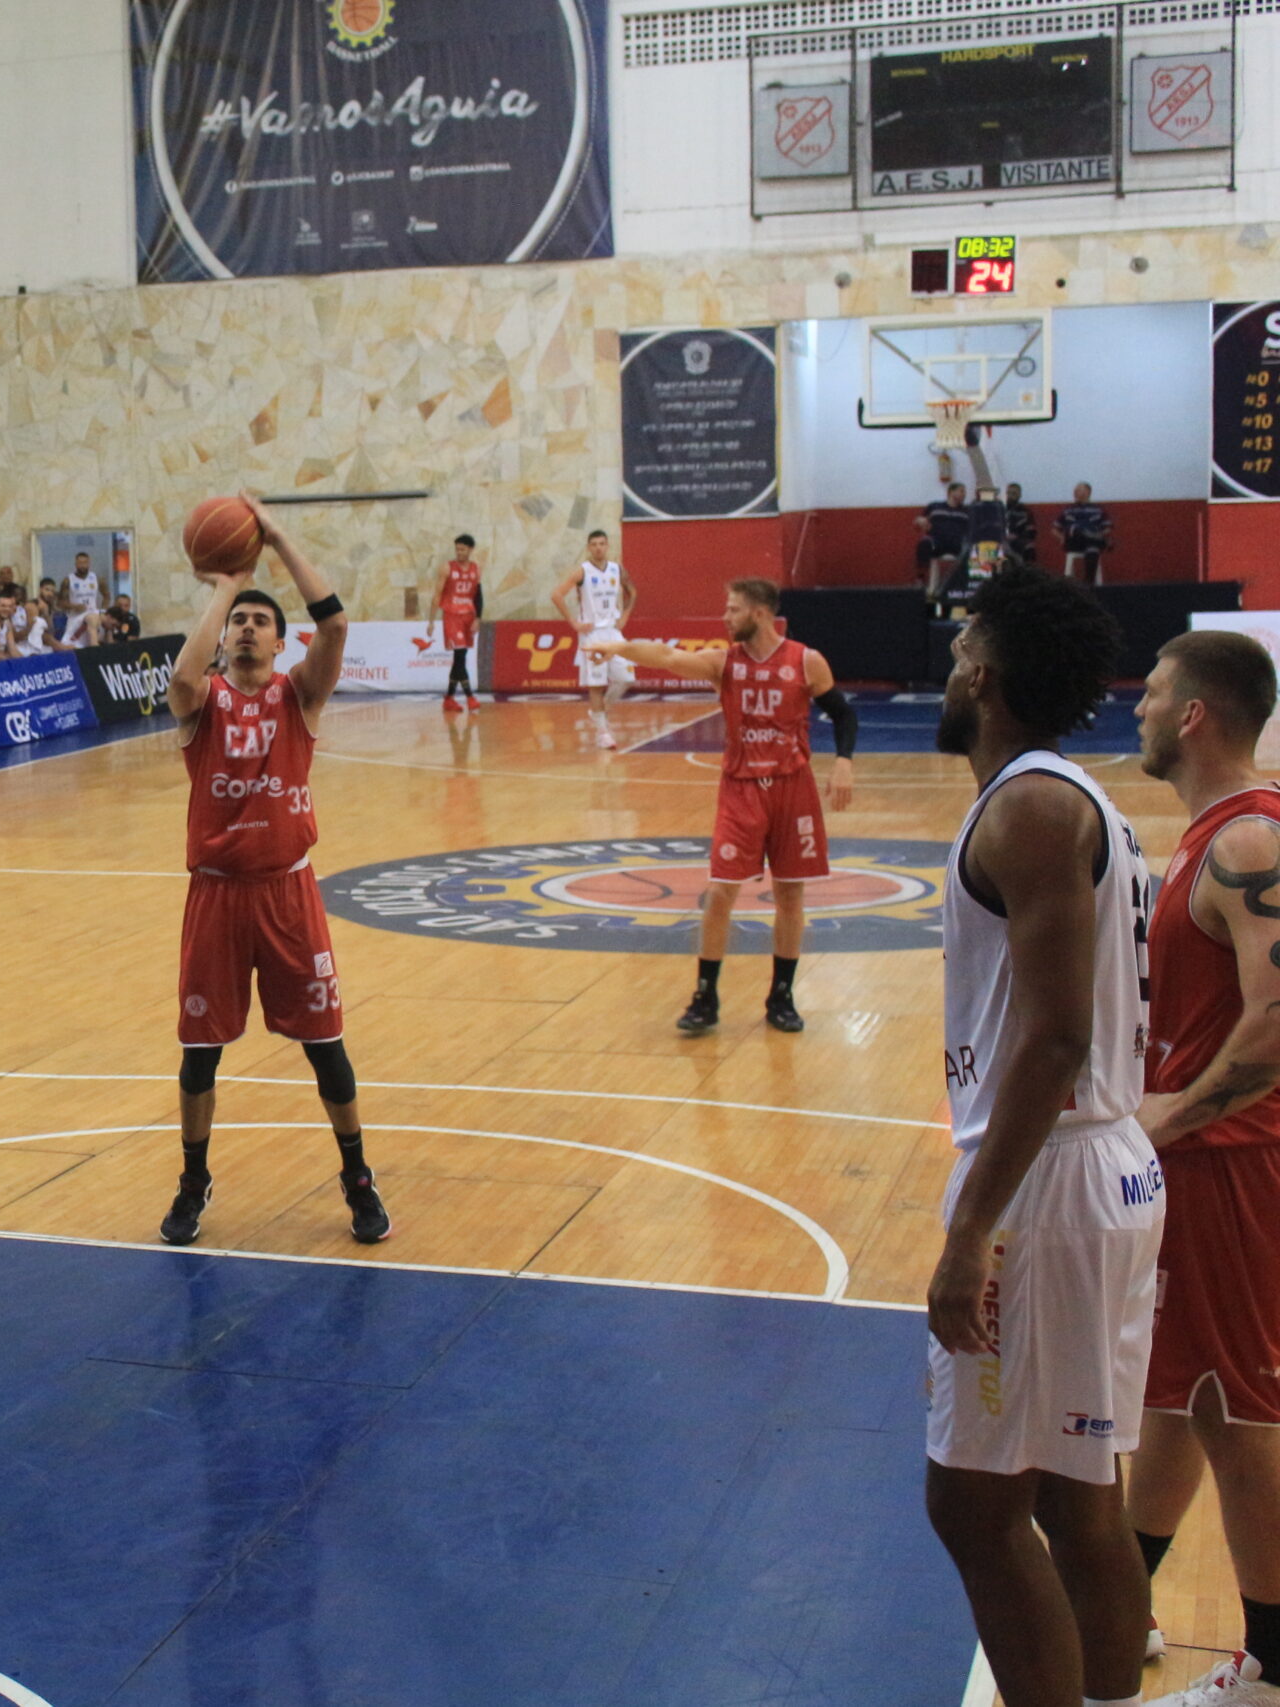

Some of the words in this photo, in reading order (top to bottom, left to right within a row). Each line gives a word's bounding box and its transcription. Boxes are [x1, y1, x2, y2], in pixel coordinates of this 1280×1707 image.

[941, 44, 1035, 63] HARDSPORT
[877, 169, 981, 193] A.E.S.J.
[1002, 158, 1110, 185] VISITANTE
[958, 238, 1014, 258] 08:32
[968, 260, 1014, 294] 24
[1246, 371, 1269, 387] #0
[1244, 393, 1268, 408] #5
[1242, 413, 1273, 429] #10
[1242, 436, 1273, 451] #13
[1243, 458, 1272, 473] #17
[741, 689, 783, 716] CAP
[225, 719, 278, 758] CAP
[287, 786, 312, 814] 33
[799, 836, 817, 858] 2
[306, 978, 341, 1012] 33
